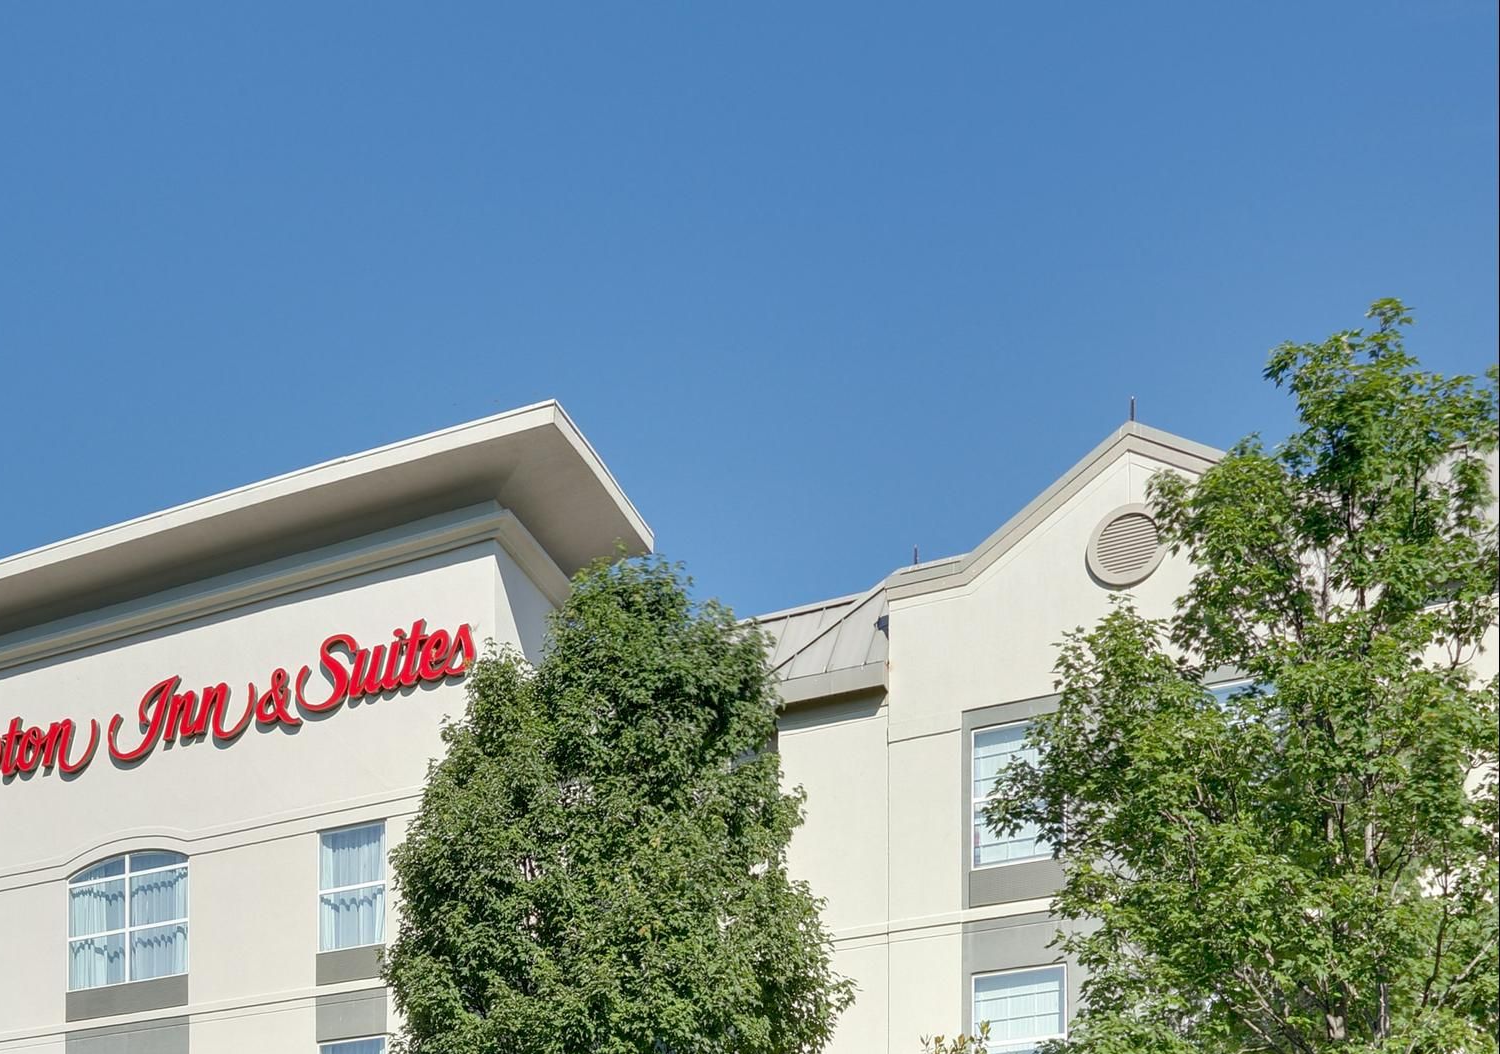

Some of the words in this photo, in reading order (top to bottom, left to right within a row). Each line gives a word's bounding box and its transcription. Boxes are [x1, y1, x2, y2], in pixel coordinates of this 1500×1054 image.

[107, 675, 256, 761] Inn
[254, 667, 302, 725] &
[294, 618, 476, 712] Suites
